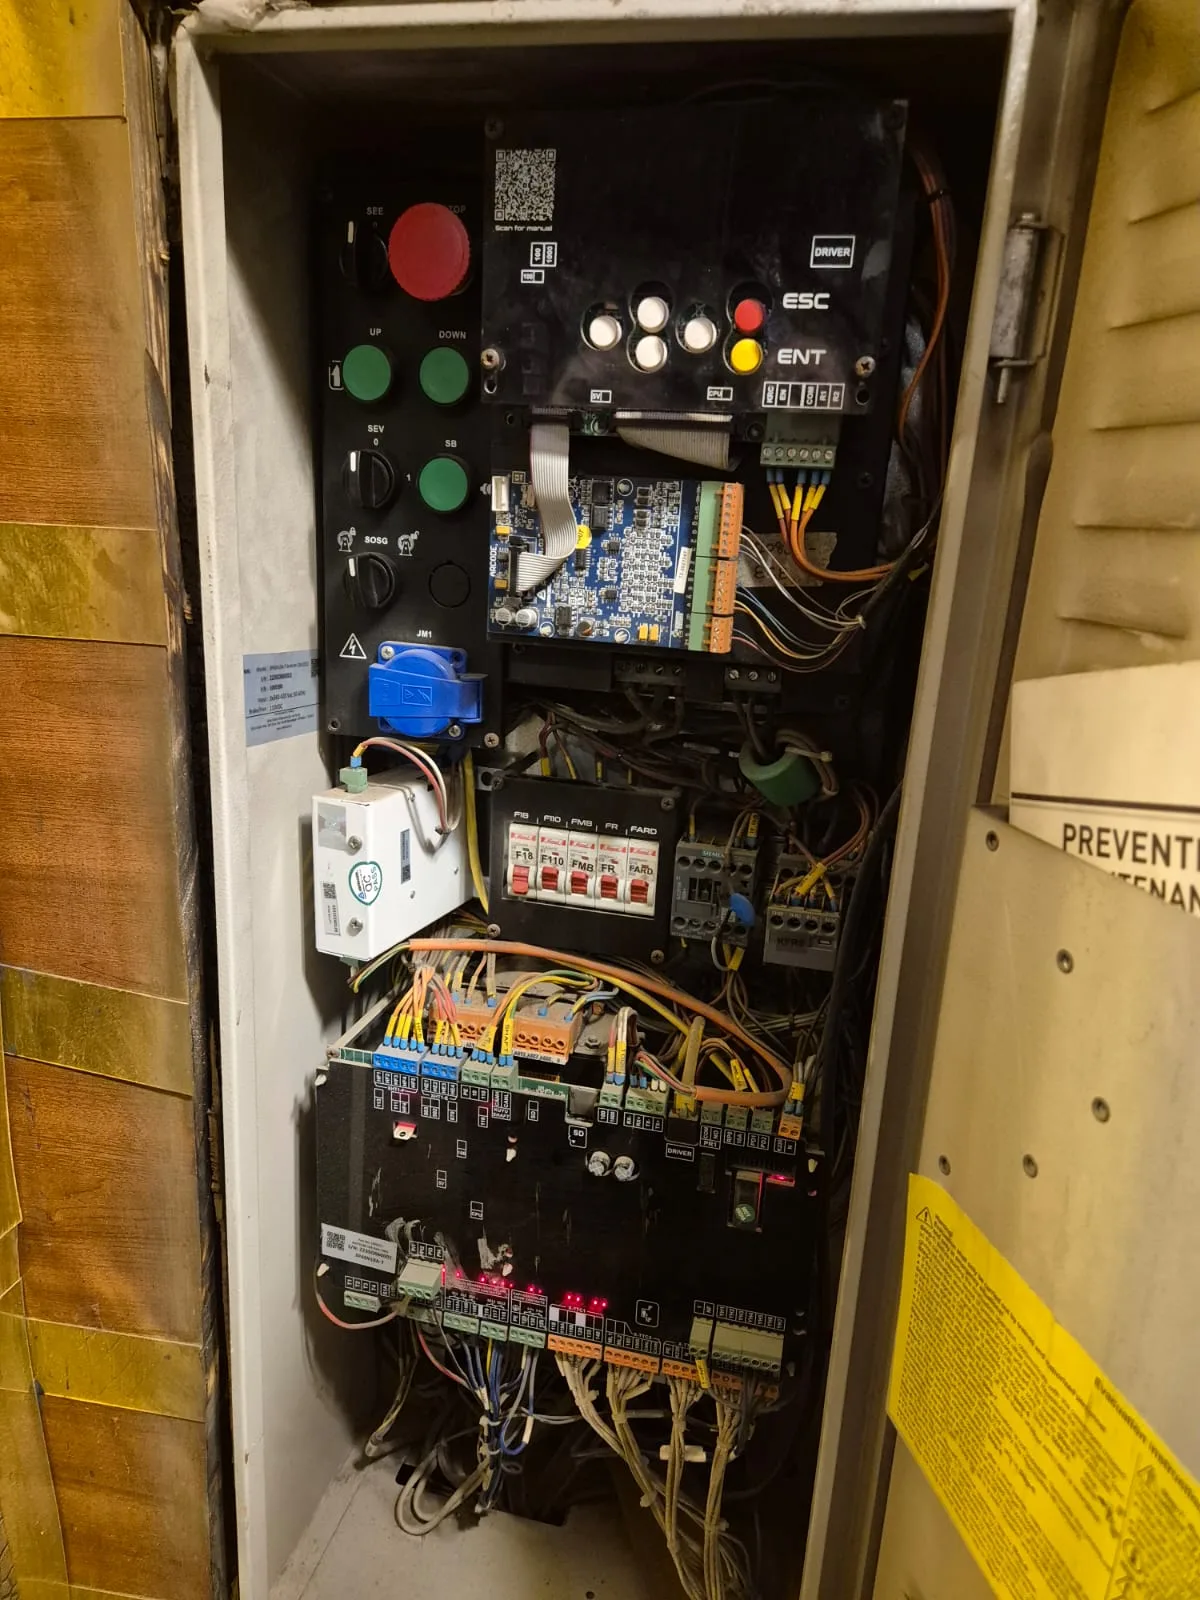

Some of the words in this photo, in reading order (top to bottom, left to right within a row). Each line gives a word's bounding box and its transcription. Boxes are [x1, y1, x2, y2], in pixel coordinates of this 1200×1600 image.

[366, 207, 384, 216] SEE
[495, 224, 513, 232] Scan
[514, 224, 525, 232] for
[814, 247, 850, 258] DRIVER
[782, 292, 831, 310] ESC
[369, 328, 382, 336] UP
[438, 330, 467, 339] DOWN
[777, 348, 827, 365] ENT
[367, 425, 385, 433] SEV
[444, 439, 457, 448] SB
[364, 535, 389, 545] SOSG
[416, 629, 433, 638] JM1
[571, 818, 593, 827] FMB
[604, 822, 619, 831] FR
[630, 825, 658, 835] FARD
[515, 850, 534, 860] F18
[541, 854, 565, 866] F110
[571, 860, 594, 873] FMB
[601, 863, 616, 874] FR
[629, 864, 654, 875] FARD
[573, 1129, 585, 1137] SD
[667, 1147, 692, 1157] DRIVER
